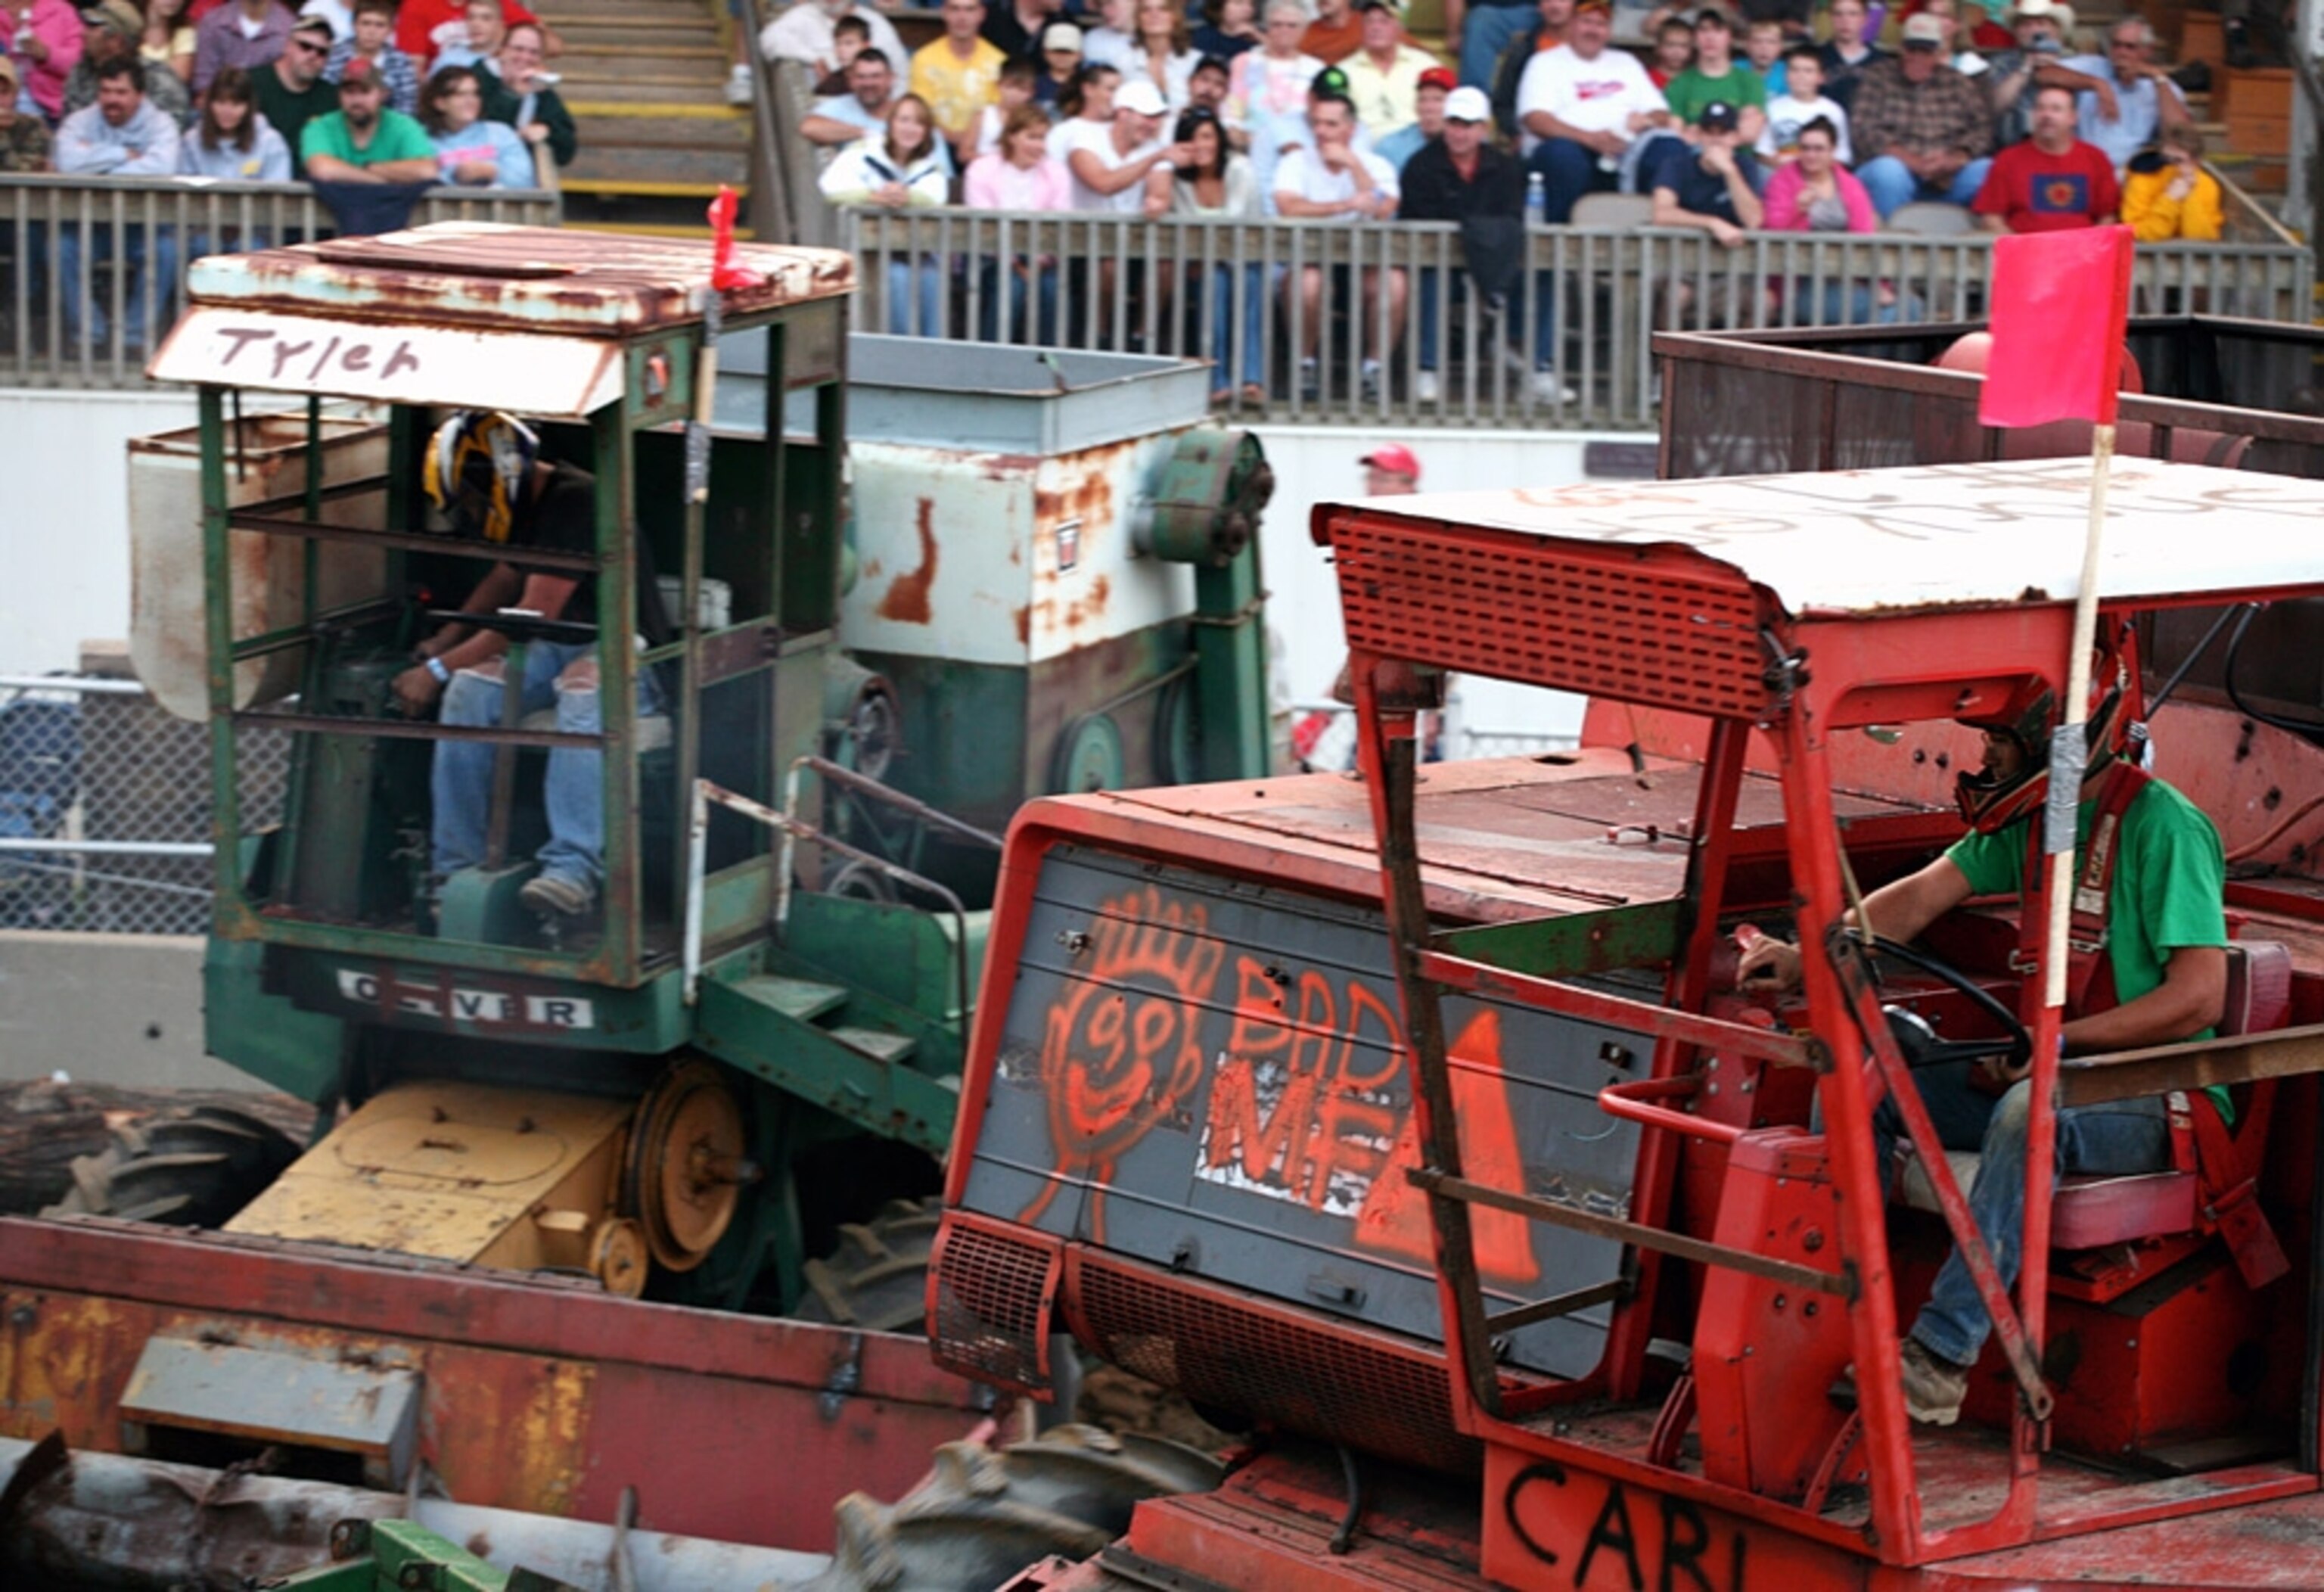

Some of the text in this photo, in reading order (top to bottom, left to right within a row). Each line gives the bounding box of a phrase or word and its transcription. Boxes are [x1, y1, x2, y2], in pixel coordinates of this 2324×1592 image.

[216, 328, 420, 381] Tyler
[355, 976, 576, 1025] OVER
[1229, 955, 1404, 1090] BAD
